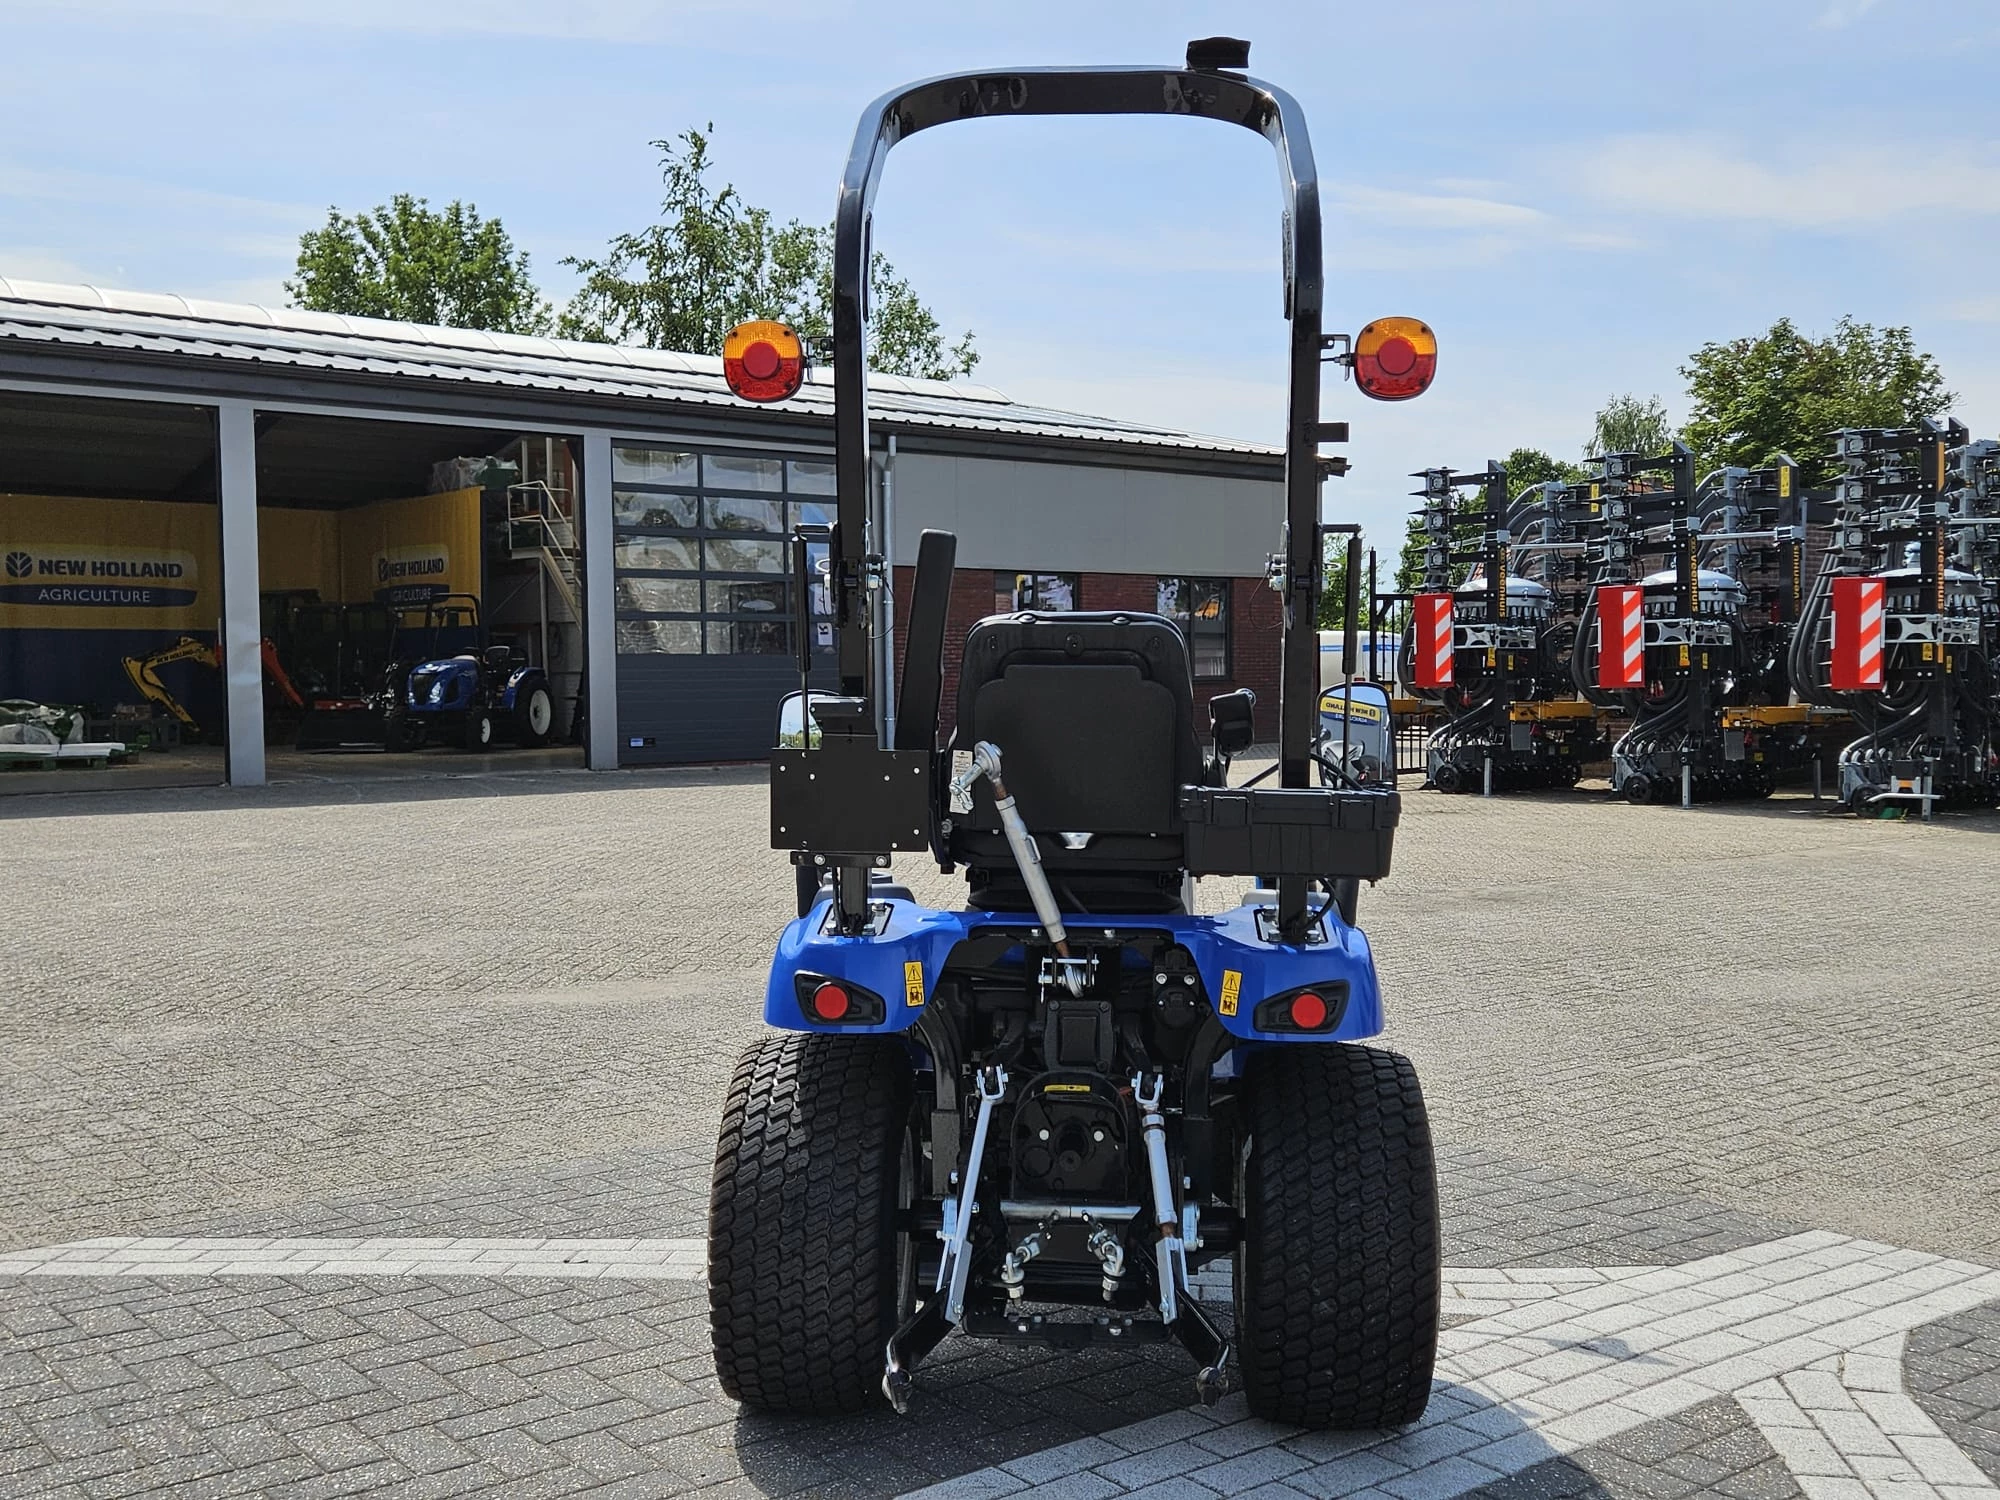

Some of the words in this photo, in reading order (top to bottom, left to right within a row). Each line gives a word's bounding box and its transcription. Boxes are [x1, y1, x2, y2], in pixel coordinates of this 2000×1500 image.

[38, 559, 86, 576] NEW
[91, 561, 183, 578] HOLLAND
[390, 561, 407, 577] NEW
[408, 558, 444, 576] HOLLAND
[38, 588, 150, 603] AGRICULTURE
